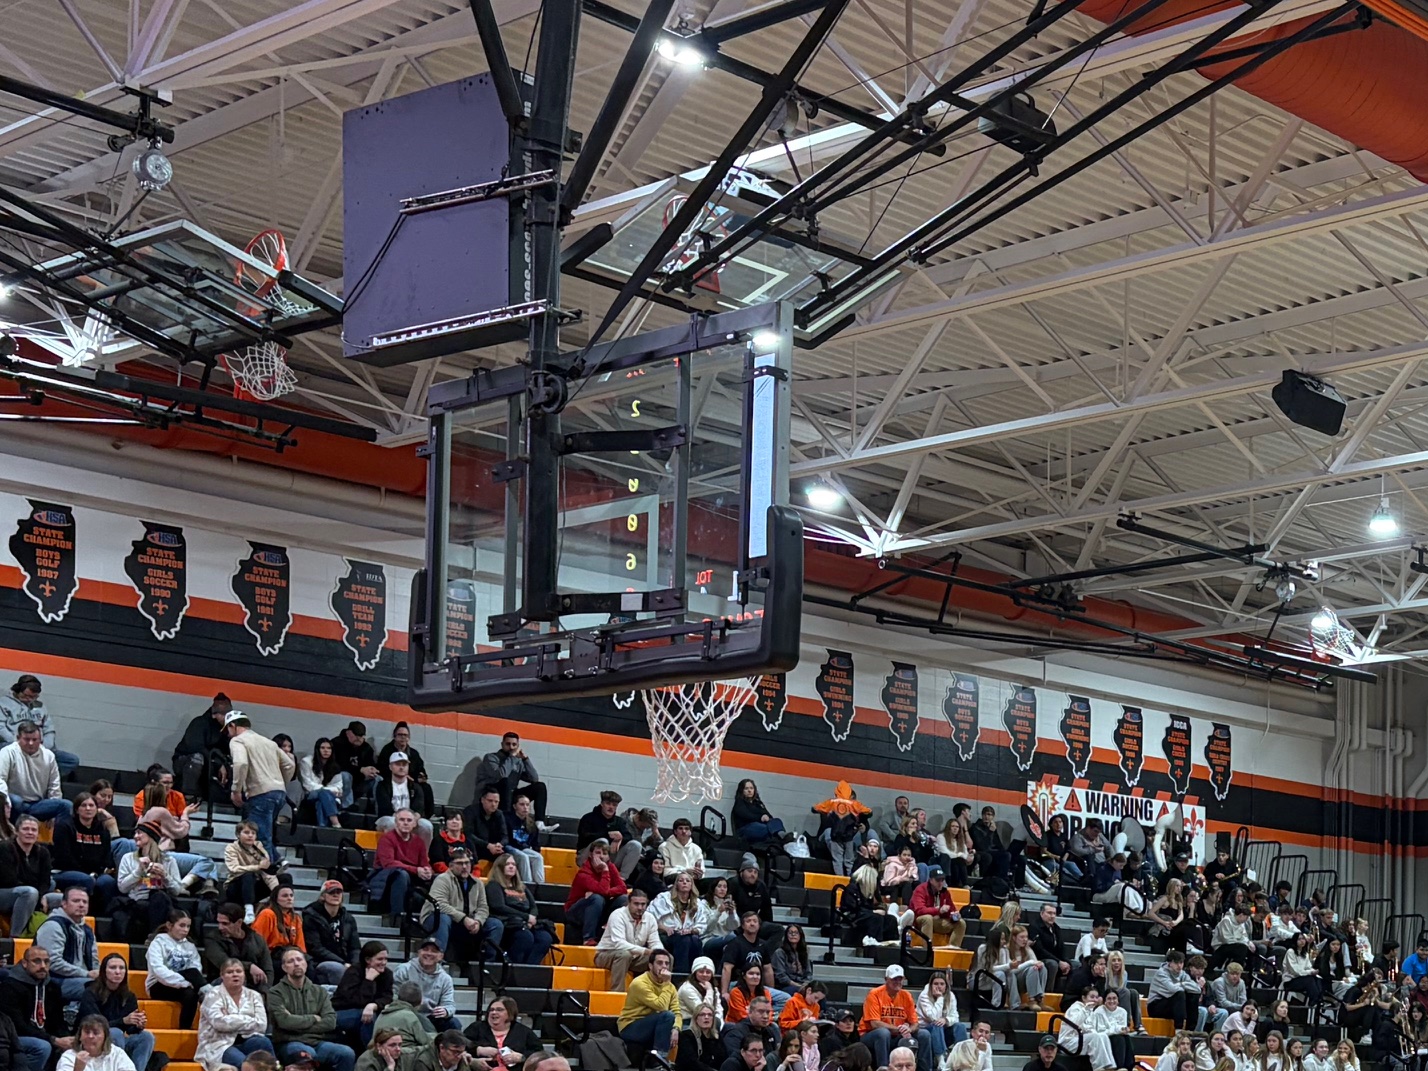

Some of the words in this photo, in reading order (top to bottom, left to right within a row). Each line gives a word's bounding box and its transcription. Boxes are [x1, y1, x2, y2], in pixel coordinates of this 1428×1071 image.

[33, 526, 64, 540] STATE
[23, 533, 73, 550] CHAMPION
[35, 548, 61, 560] BOYS
[146, 547, 176, 560] STATE
[35, 557, 60, 569] GOLF
[137, 553, 184, 569] CHAMPION
[147, 568, 174, 580] GIRLS
[252, 566, 280, 578] STATE
[143, 576, 178, 590] SOCCER
[244, 573, 287, 588] CHAMPION
[351, 584, 377, 595] STATE
[344, 591, 384, 605] CHAMPION
[1085, 790, 1154, 822] WARNING
